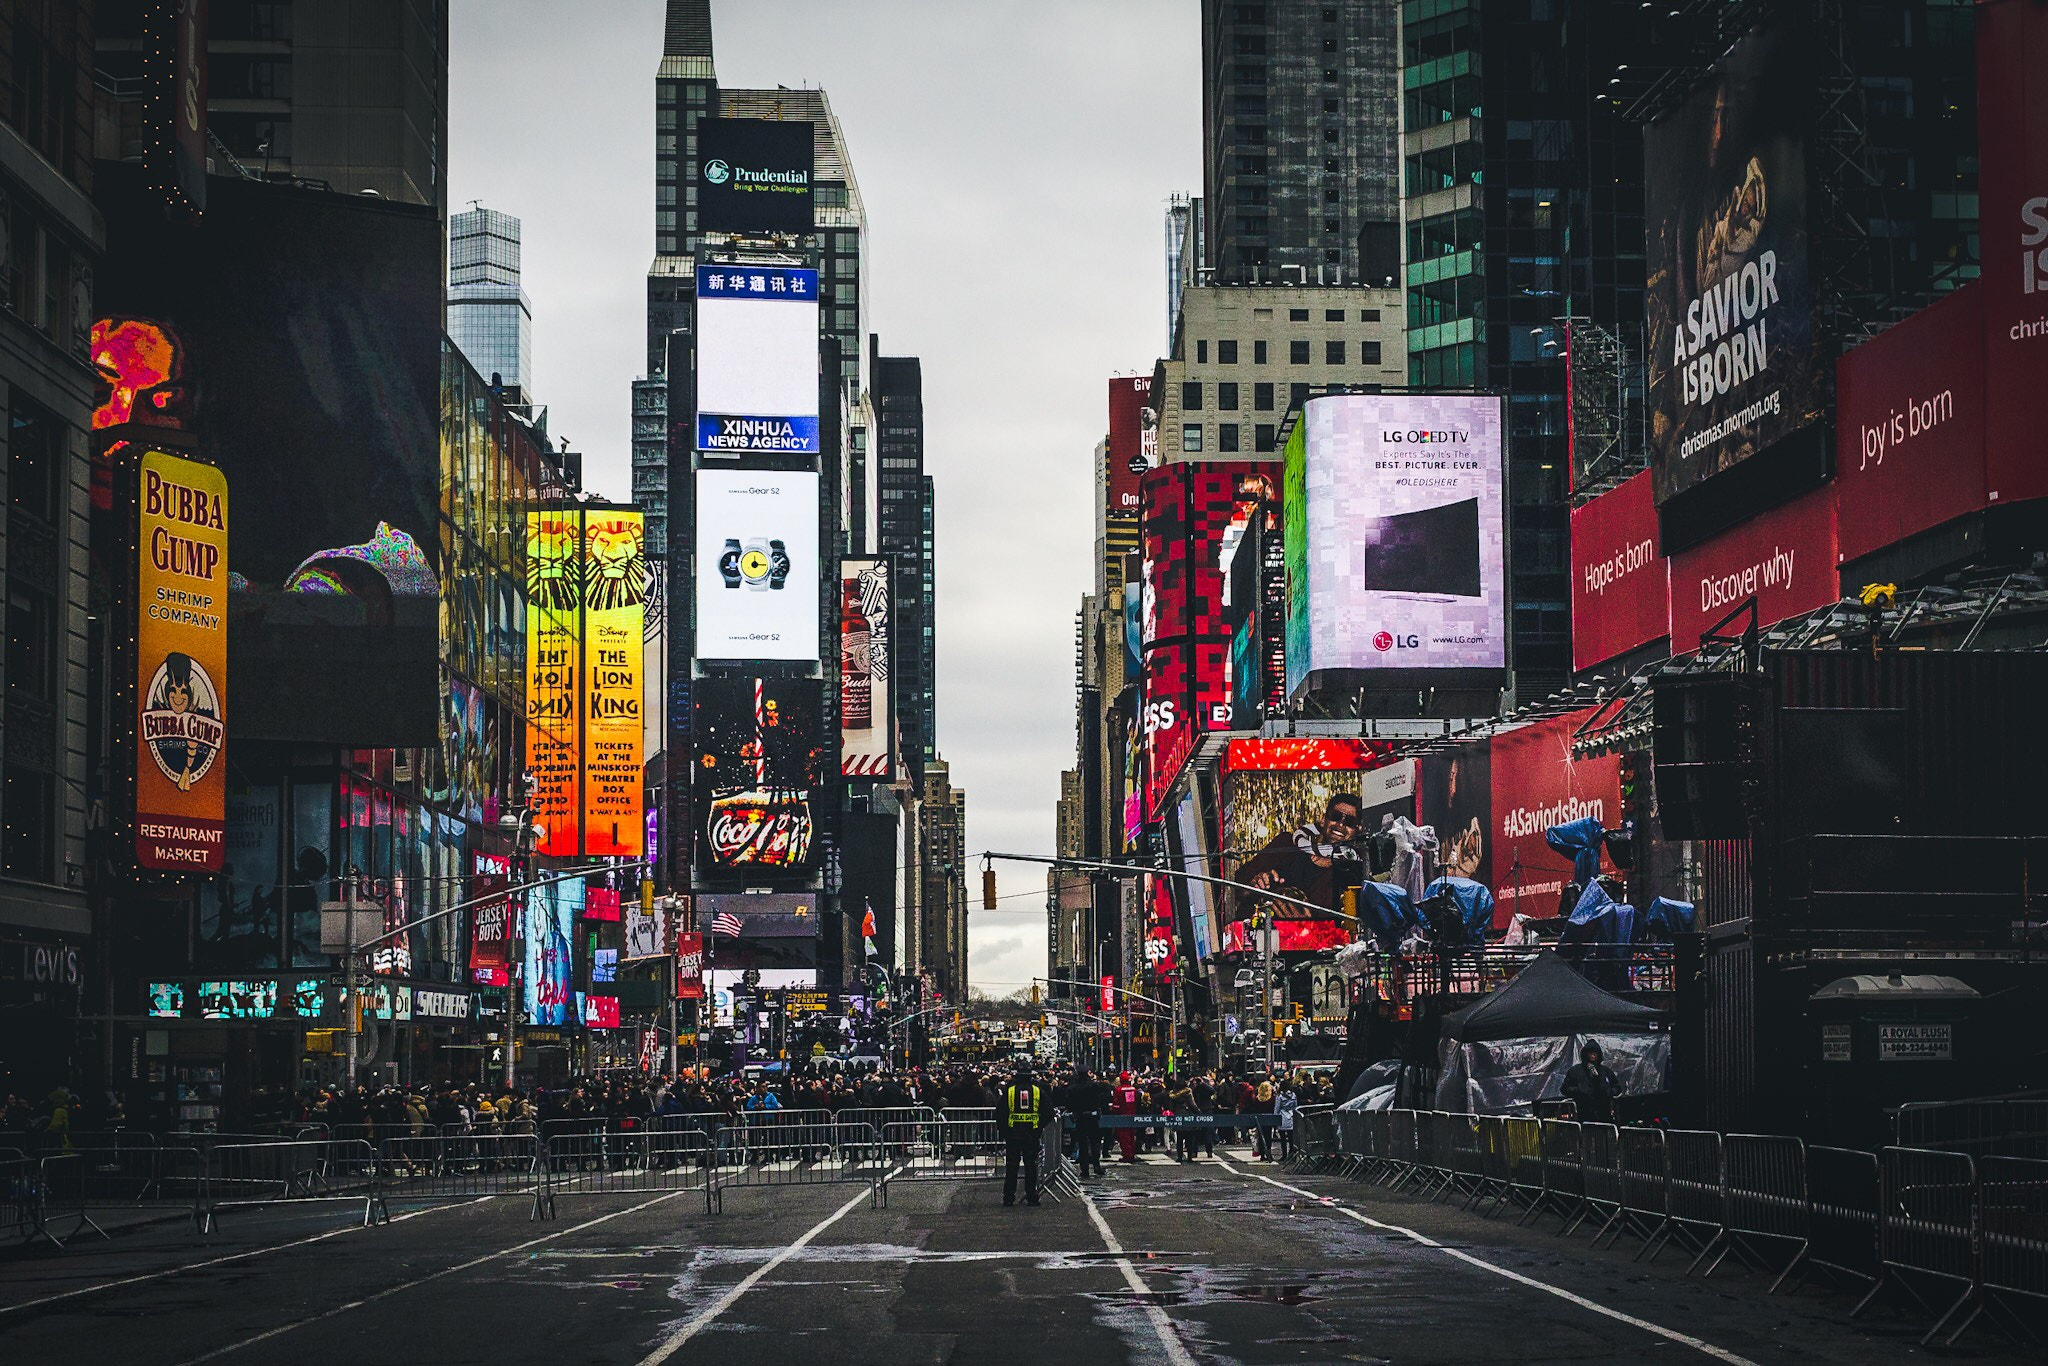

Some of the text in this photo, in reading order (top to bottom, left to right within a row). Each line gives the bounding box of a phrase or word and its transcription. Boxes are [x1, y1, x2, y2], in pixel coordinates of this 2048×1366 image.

[735, 167, 808, 183] Prudential
[734, 183, 809, 194] Bring Your Challenges
[708, 274, 806, 292] 新华通讯社
[1674, 250, 1780, 367] A SAVIOR
[1682, 317, 1768, 406] IS BORN
[723, 420, 794, 436] XINHUA
[1680, 390, 1781, 460] christmas.mormon.org
[1860, 389, 1953, 471] Joy is born
[708, 435, 809, 449] NEWS AGENCY
[1383, 430, 1469, 443] LG OLED TV
[1383, 450, 1470, 460] Experts Say It's The
[1375, 462, 1482, 470] BEST. PICTURE. EVER.
[1396, 478, 1458, 487] #OLEDISHERE
[748, 487, 770, 495] Gear
[770, 487, 780, 495] S2
[145, 469, 225, 534] BUBBA
[150, 525, 219, 581] GUMP
[1584, 538, 1653, 596] Hope is born
[1701, 545, 1795, 613] Discover why
[156, 587, 214, 609] SHRIMP
[148, 604, 220, 630] COMPANY
[748, 633, 770, 641] Gear
[771, 633, 780, 641] S2
[1397, 634, 1484, 649] LG www.LG.com
[598, 649, 627, 663] THE
[593, 666, 633, 690] LION
[590, 691, 639, 719] KING
[158, 740, 187, 750] SHRIMP
[594, 742, 634, 751] TICKETS
[597, 753, 631, 761] AT THE
[587, 763, 641, 772] MINSKOFF
[592, 774, 635, 783] THEATRE
[602, 785, 625, 794] BOX
[596, 796, 632, 805] OFFICE
[1503, 796, 1604, 839] #ASaviorIsBorn
[140, 822, 223, 844] RESTAURANT
[155, 846, 209, 864] MARKET
[1498, 880, 1562, 900] christas.mormon.org
[475, 902, 508, 926] JERSEY
[1050, 893, 1058, 954] WELLINGTON
[478, 923, 502, 942] BOYS
[678, 953, 703, 968] JERSEY
[681, 965, 699, 979] BOYS
[416, 990, 469, 1018] SKECHERS
[1882, 1027, 1949, 1038] A ROYAL FLUSH
